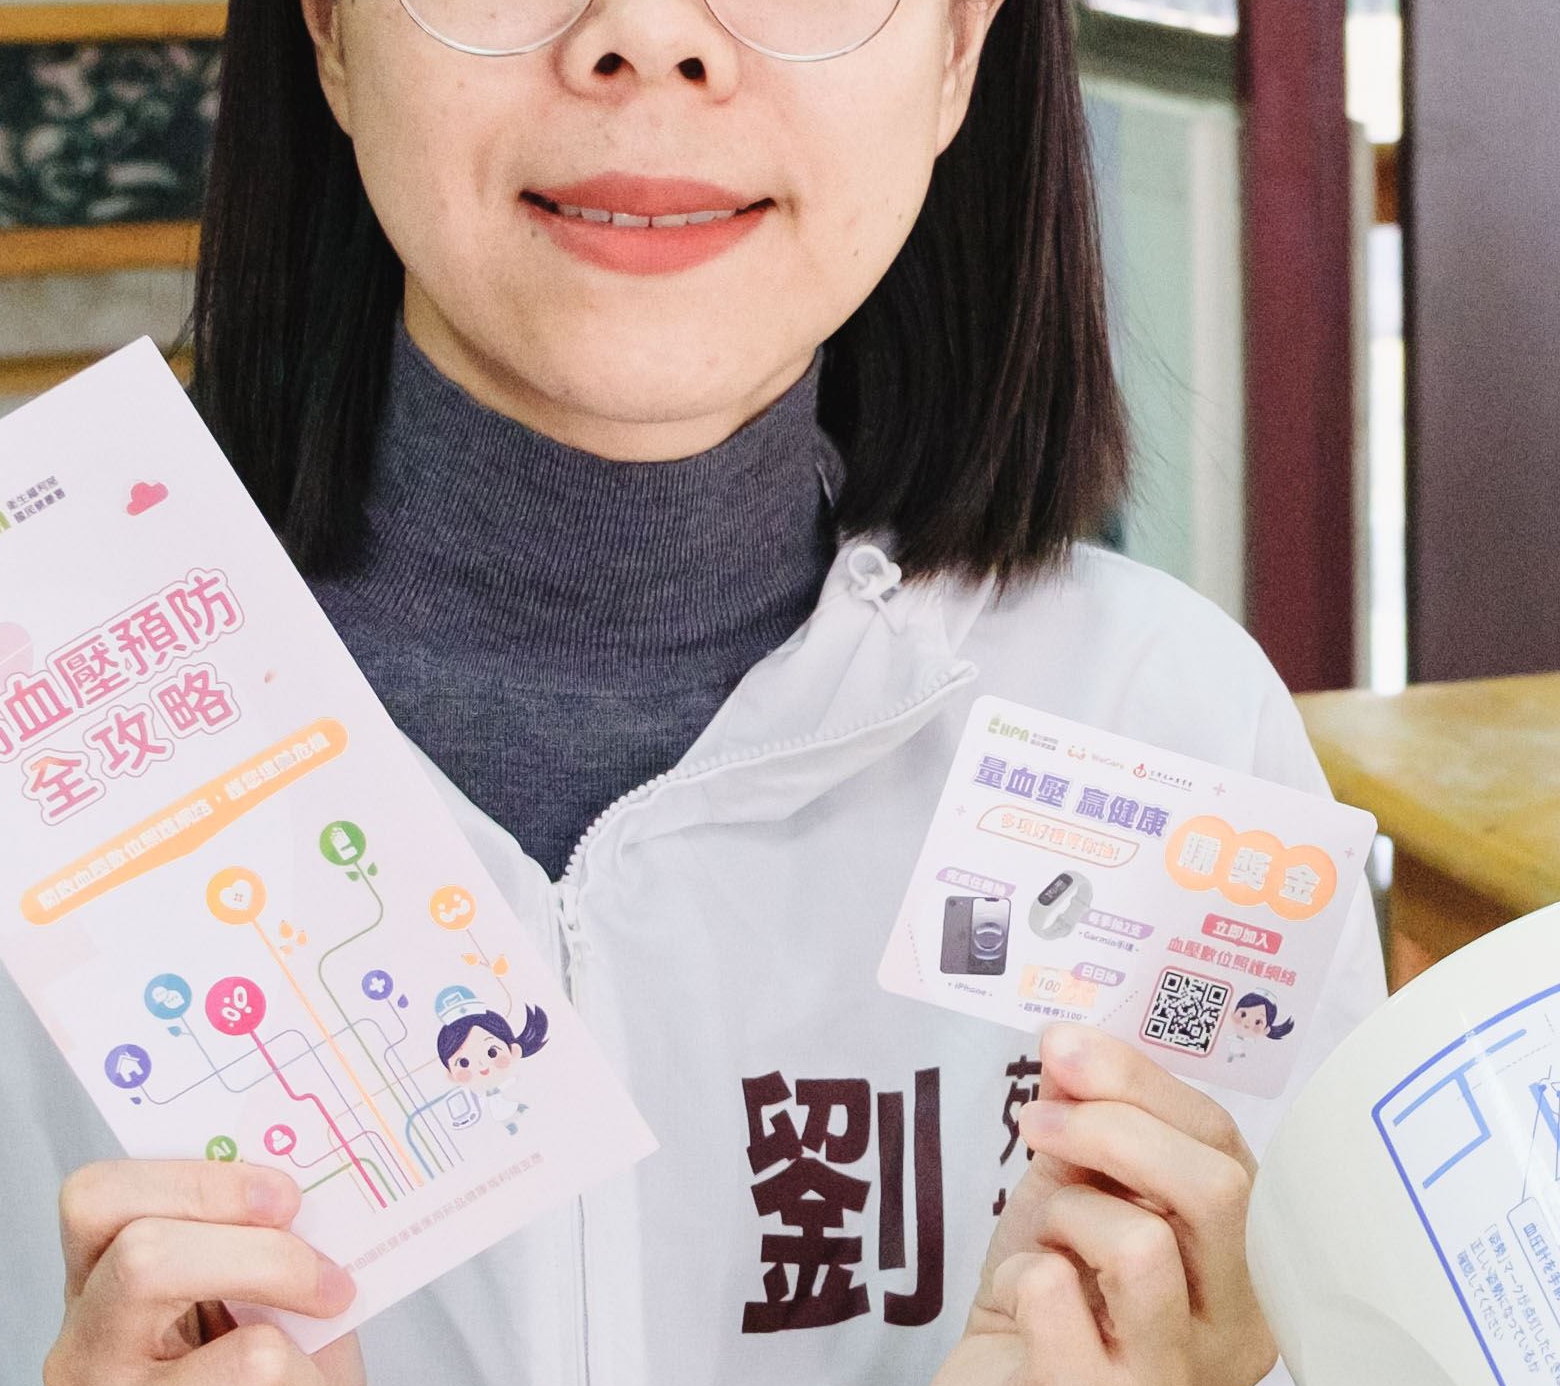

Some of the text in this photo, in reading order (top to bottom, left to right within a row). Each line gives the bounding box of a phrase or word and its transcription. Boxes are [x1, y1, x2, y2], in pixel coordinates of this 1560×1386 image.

[30, 669, 233, 817] 全攻略
[974, 755, 1169, 837] 量血壓 贏健康
[1212, 920, 1269, 949] 立即加入
